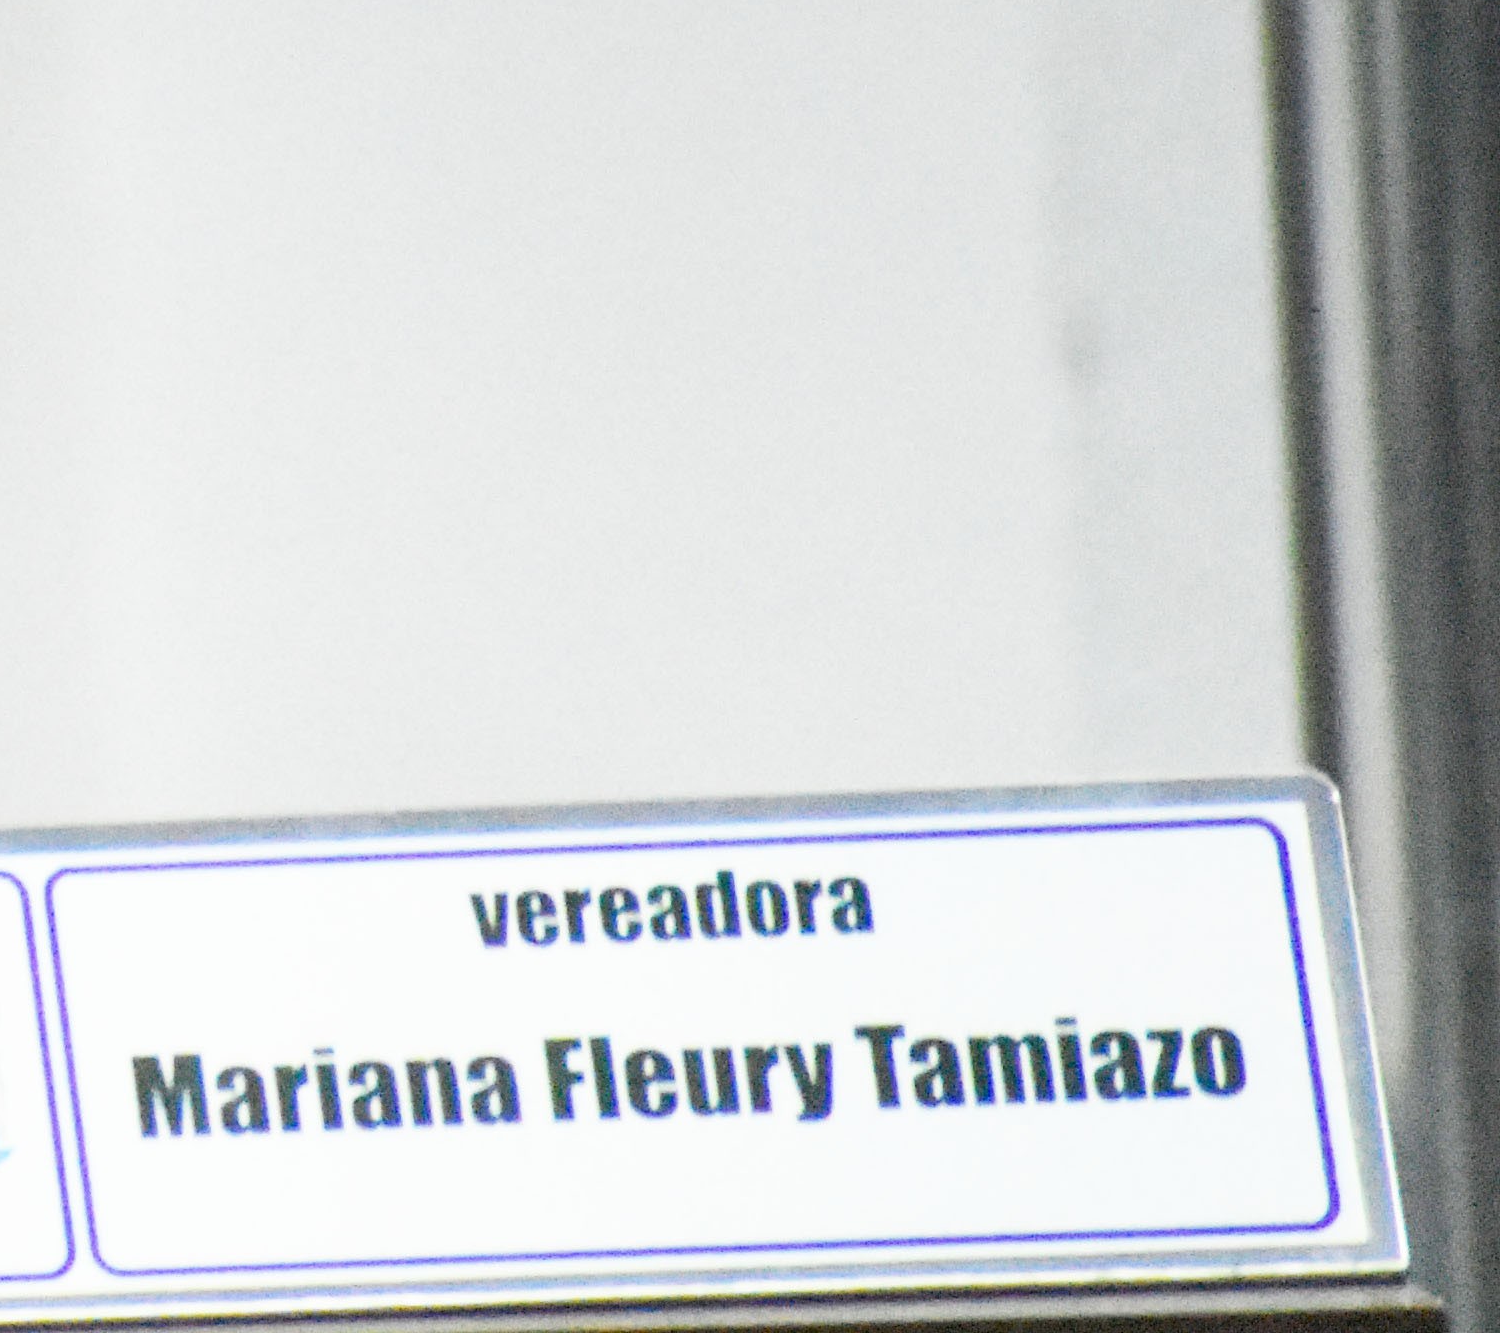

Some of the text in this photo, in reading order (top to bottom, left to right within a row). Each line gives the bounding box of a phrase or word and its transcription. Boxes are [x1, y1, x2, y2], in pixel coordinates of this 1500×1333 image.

[472, 871, 874, 946] vereadora
[134, 1016, 1247, 1137] Mariana Fleury Tamiazo
